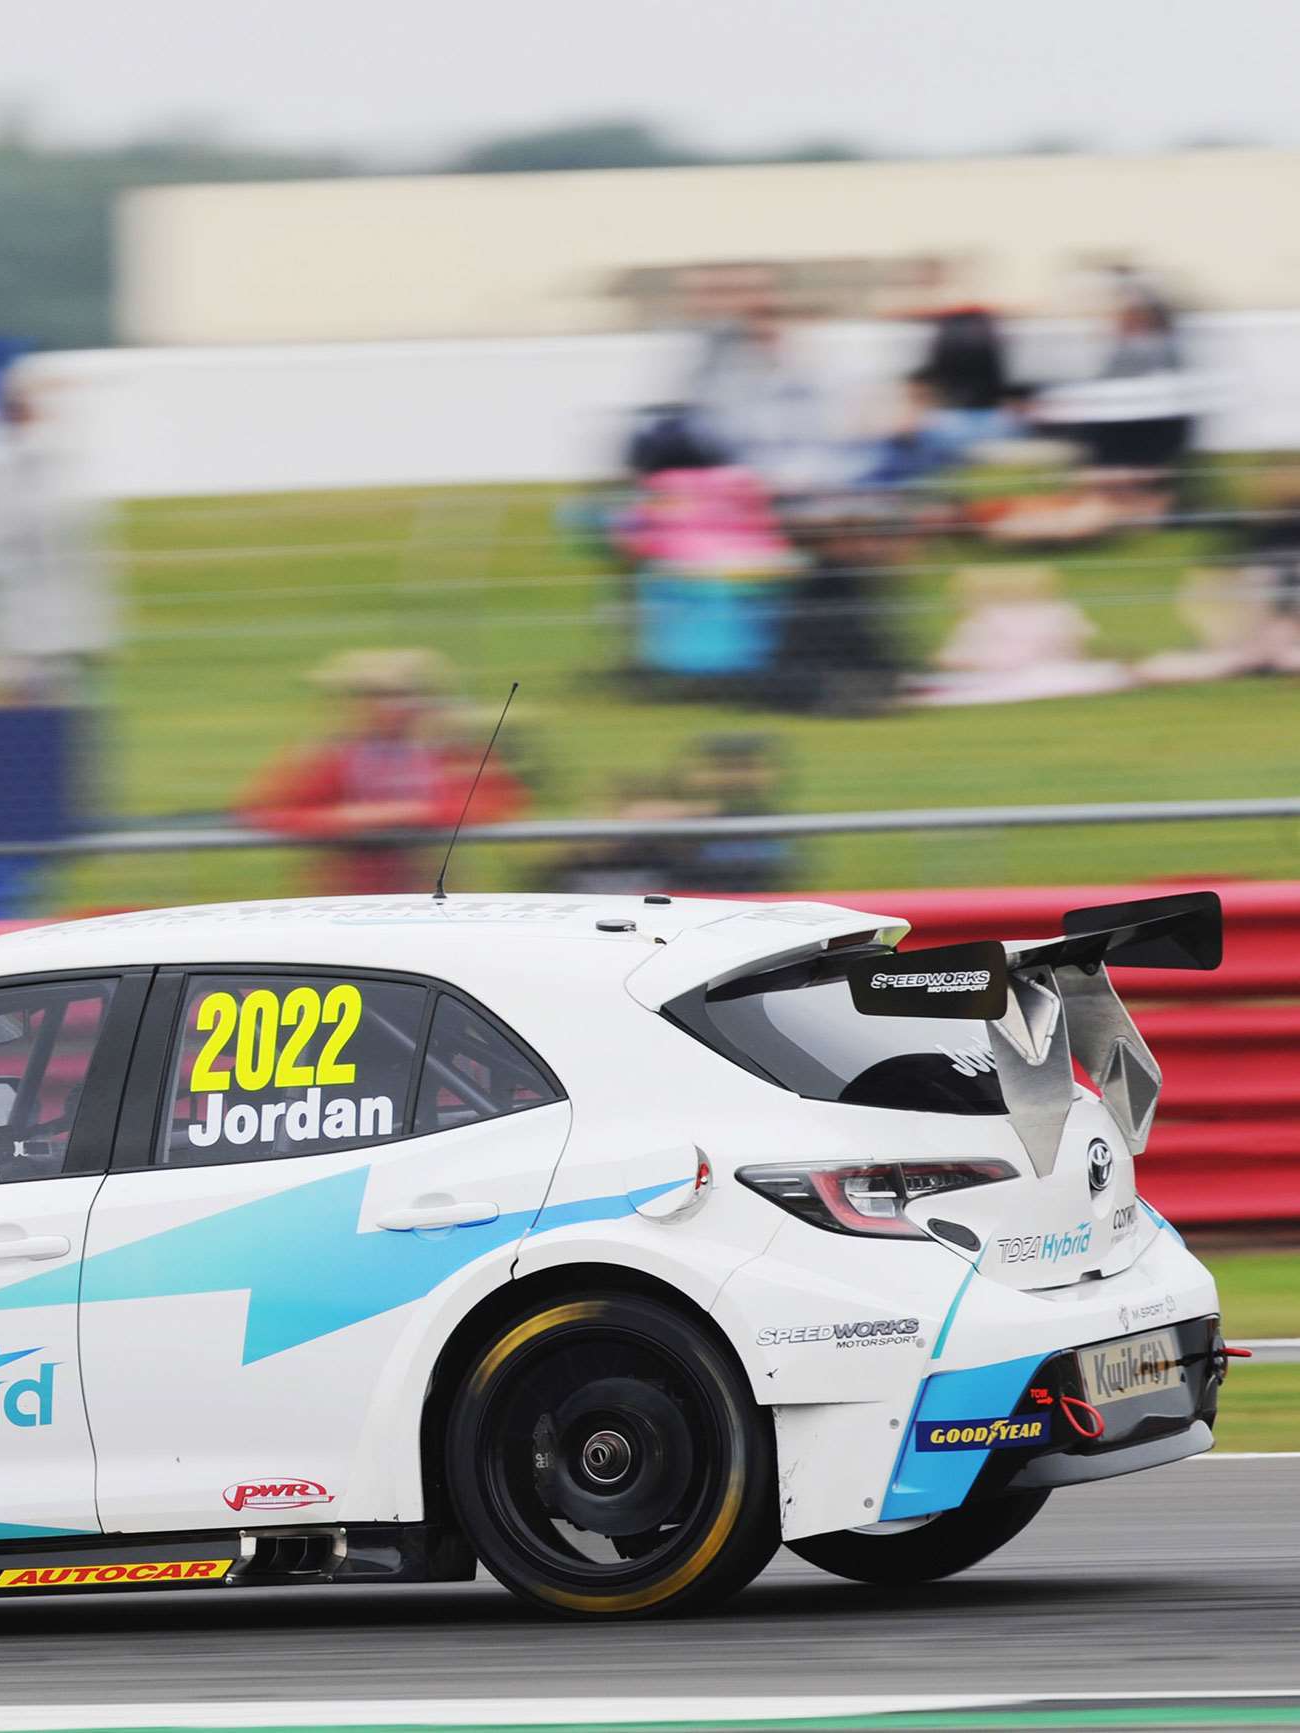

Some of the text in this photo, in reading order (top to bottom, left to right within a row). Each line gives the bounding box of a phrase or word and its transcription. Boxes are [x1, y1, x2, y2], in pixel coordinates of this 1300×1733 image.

[871, 970, 990, 989] SPEEDWORKS
[927, 984, 989, 993] MOTORSPORT
[190, 984, 363, 1092] 2022
[188, 1087, 394, 1148] Jordan
[1041, 1226, 1092, 1263] Hybrid
[756, 1317, 919, 1346] SPEEDWORKS
[836, 1335, 917, 1349] MOTORSPORT
[8, 1561, 218, 1586] AUTOCAR
